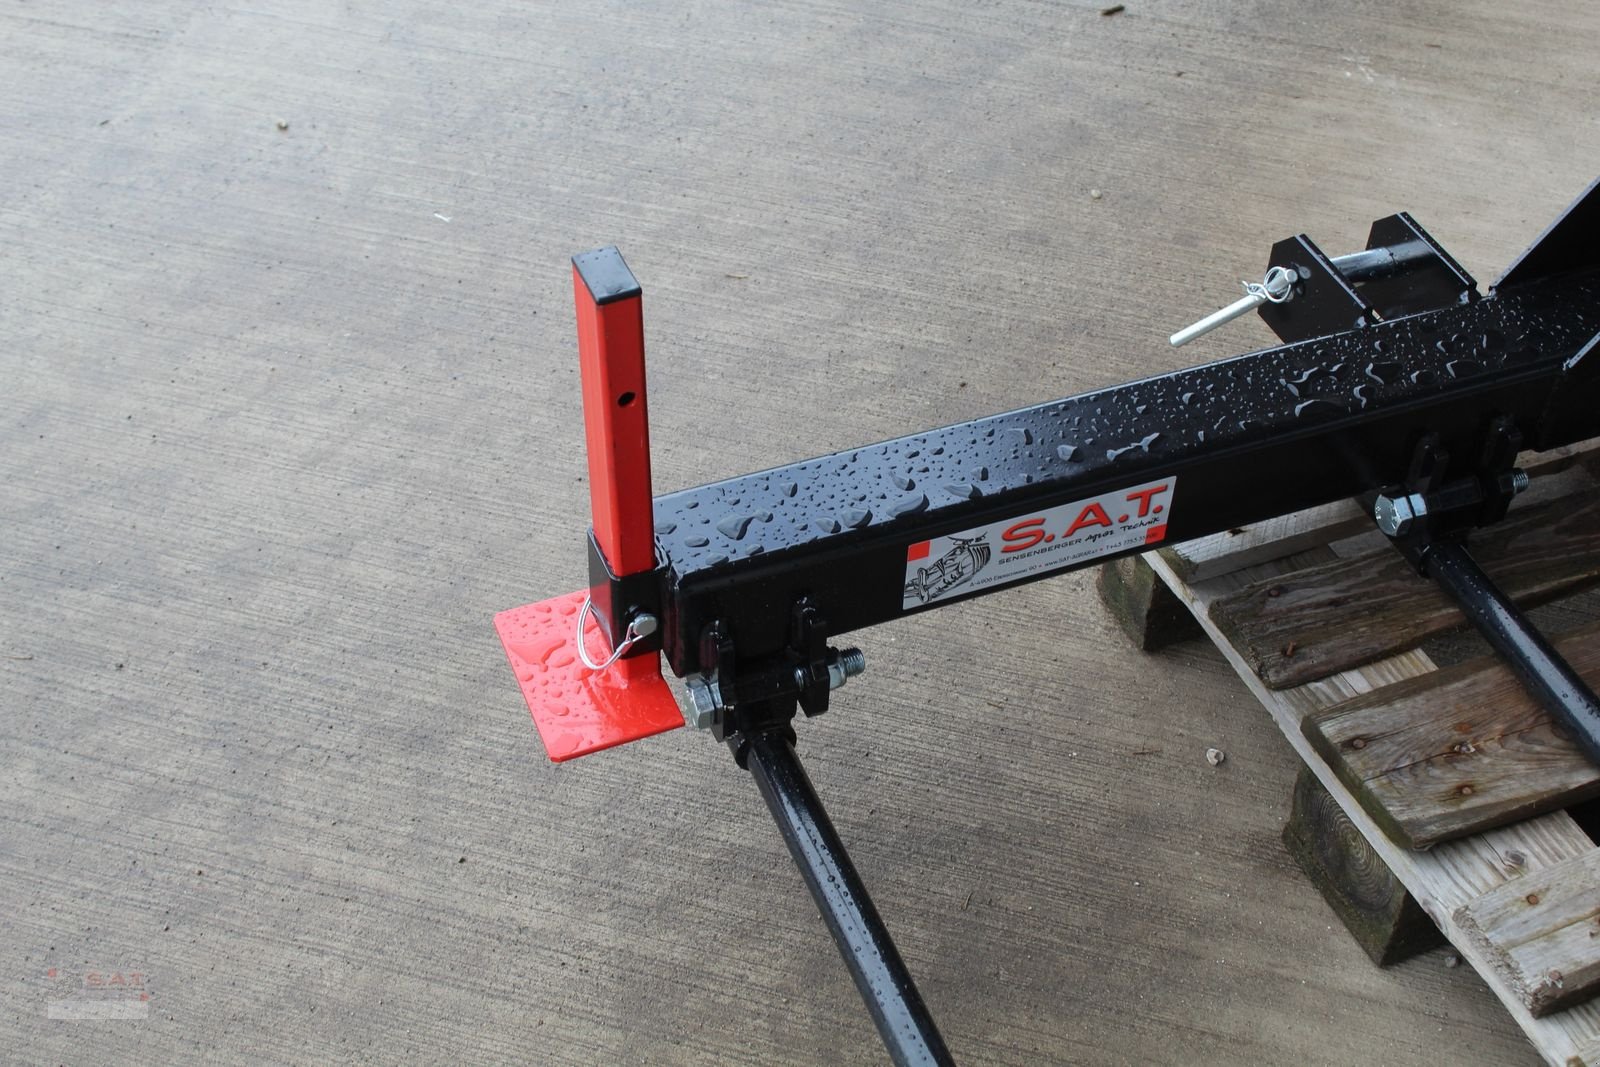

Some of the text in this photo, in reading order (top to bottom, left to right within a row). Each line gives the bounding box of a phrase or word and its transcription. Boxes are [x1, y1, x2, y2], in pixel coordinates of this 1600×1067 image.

[999, 538, 1082, 565] SENSENBERGER
[1119, 516, 1160, 532] Technik
[1001, 484, 1168, 553] S.A.T.
